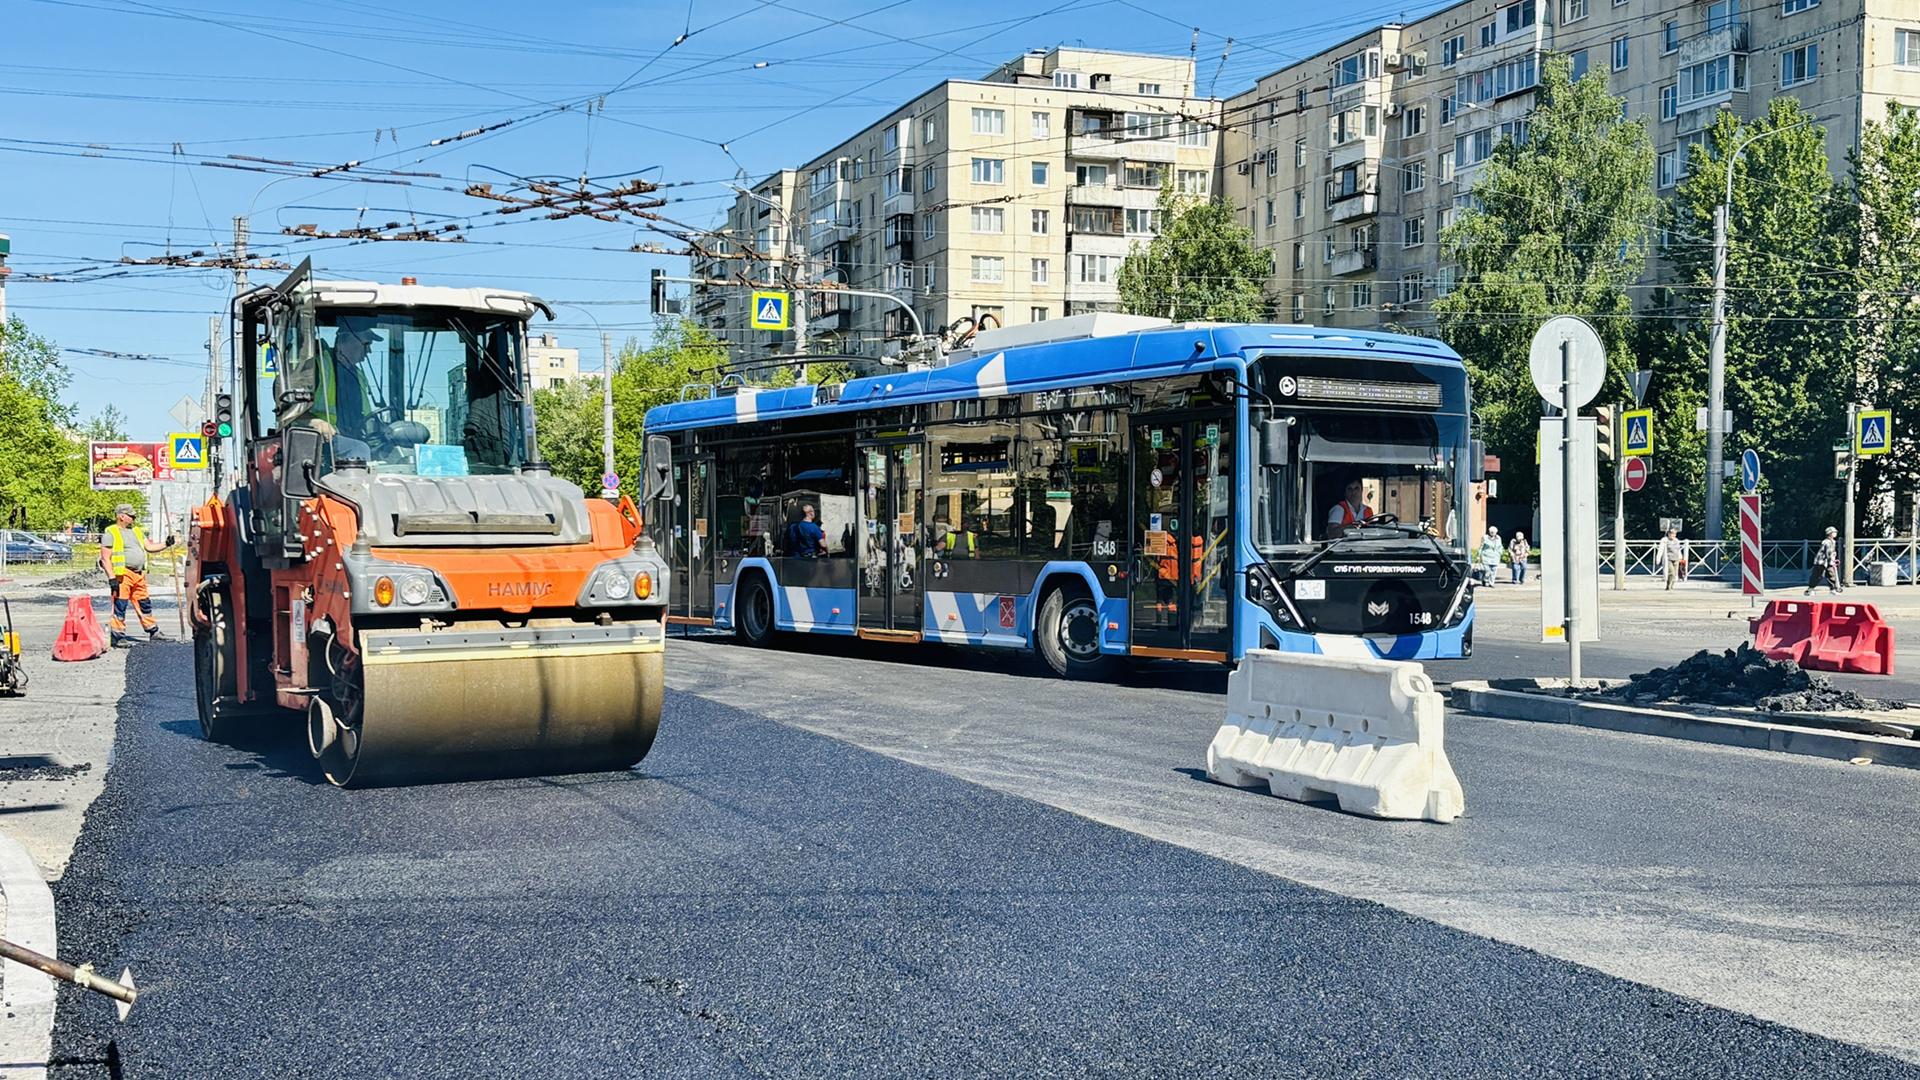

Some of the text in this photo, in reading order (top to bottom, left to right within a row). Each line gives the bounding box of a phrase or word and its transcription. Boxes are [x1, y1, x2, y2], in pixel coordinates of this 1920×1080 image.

[1093, 540, 1116, 556] 1548
[1348, 565, 1362, 573] ГУП
[1409, 612, 1432, 625] 1548
